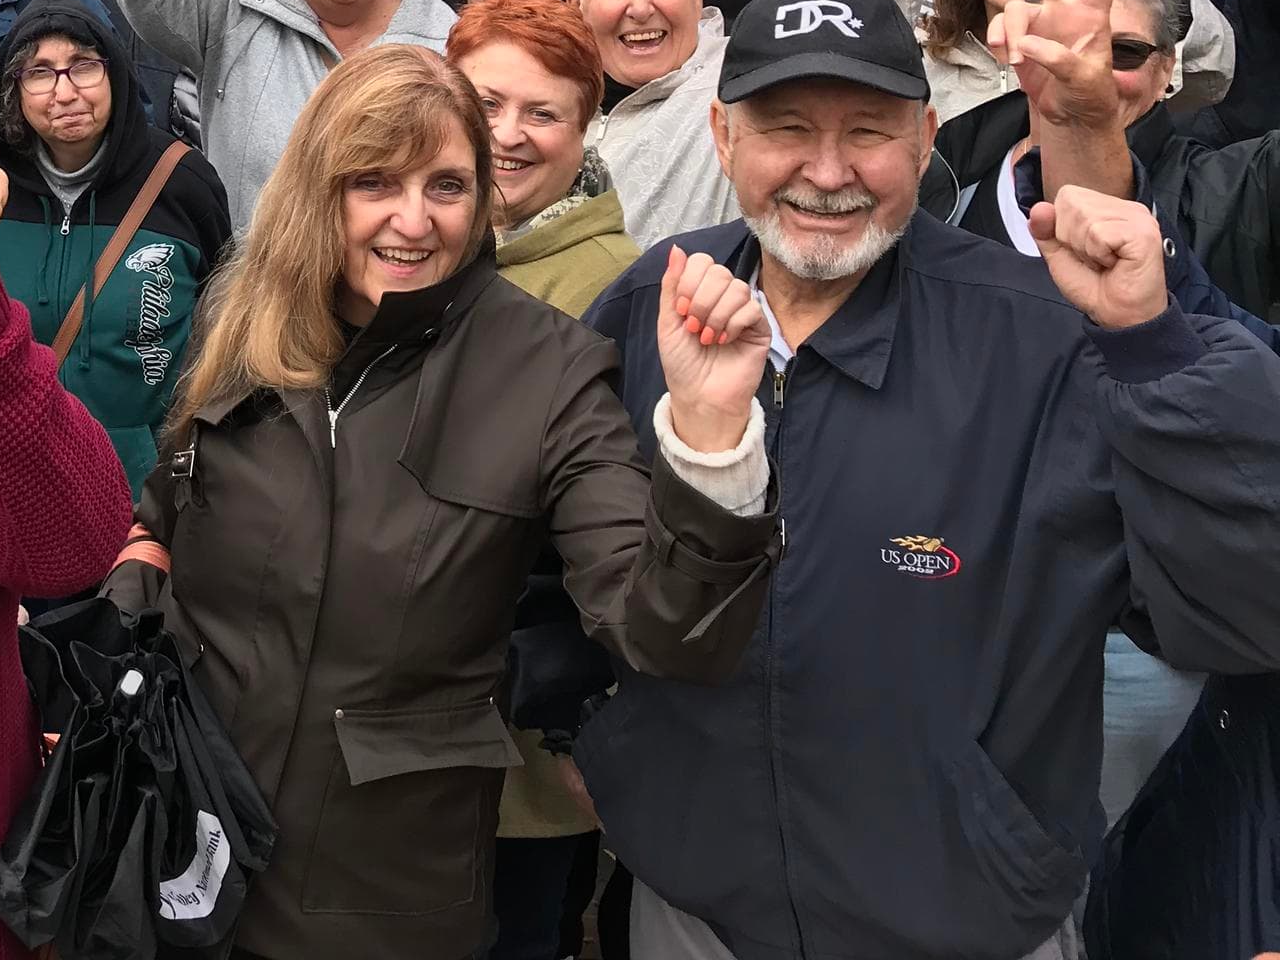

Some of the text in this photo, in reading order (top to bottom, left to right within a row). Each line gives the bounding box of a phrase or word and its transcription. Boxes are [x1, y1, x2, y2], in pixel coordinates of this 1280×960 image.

[124, 266, 174, 385] Philadelphia
[880, 548, 950, 570] US OPEN
[897, 565, 934, 574] 2002
